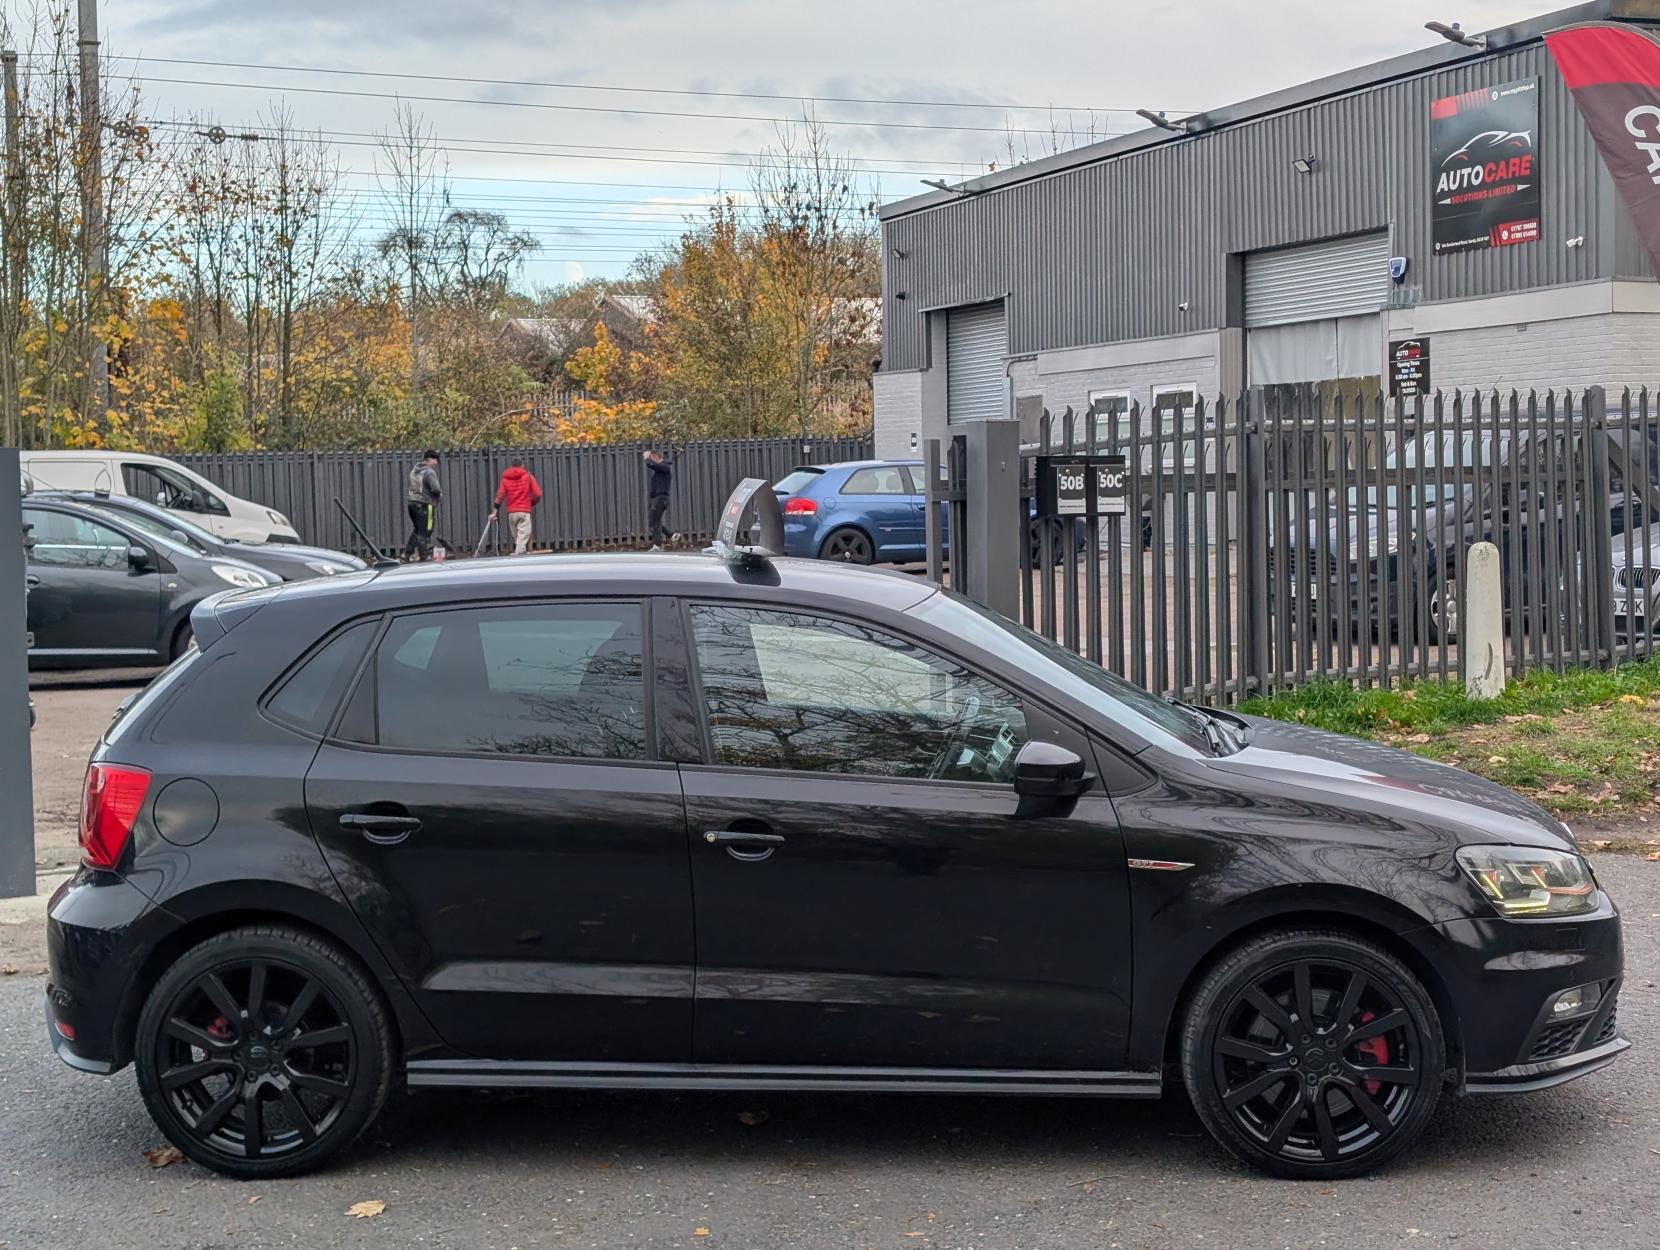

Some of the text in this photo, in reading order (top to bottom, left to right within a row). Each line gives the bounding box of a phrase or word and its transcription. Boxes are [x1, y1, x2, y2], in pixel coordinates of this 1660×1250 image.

[1451, 184, 1516, 205] SOLUTIONS LIMITED
[1060, 475, 1084, 490] 50B
[1099, 474, 1123, 488] 50C
